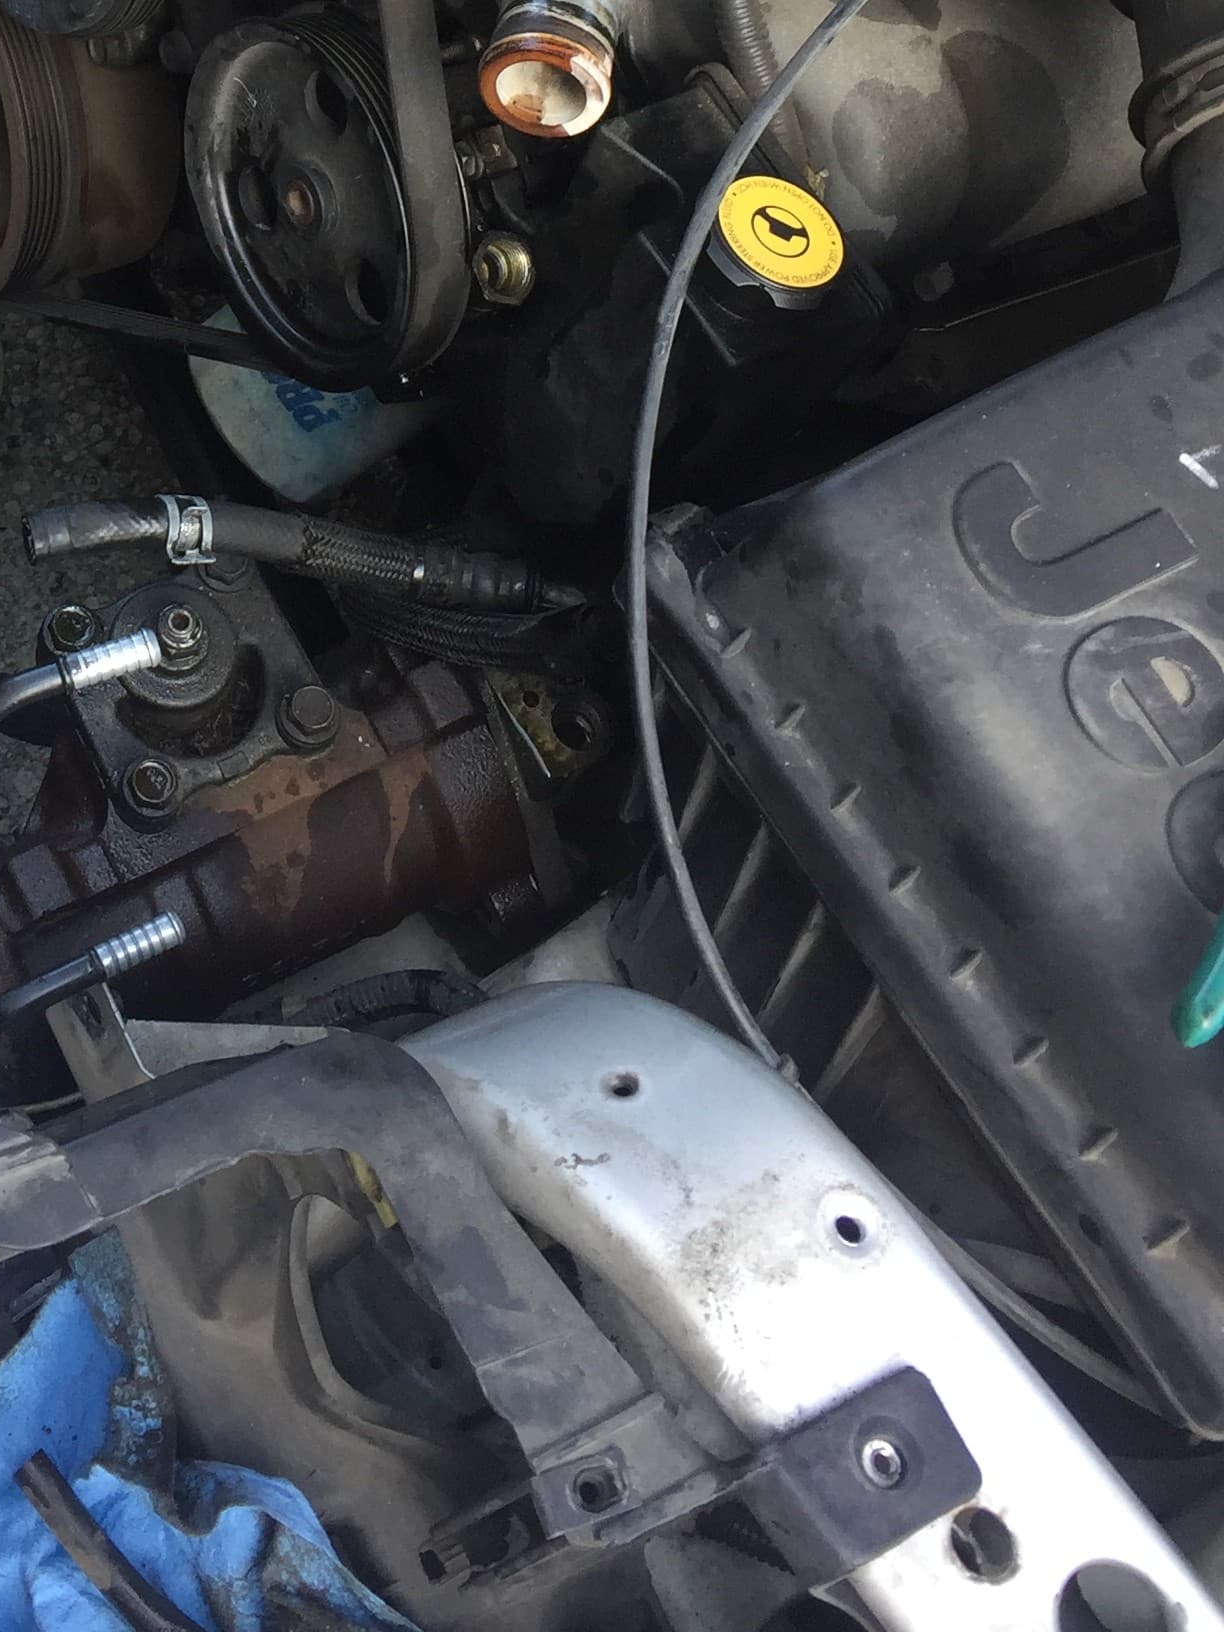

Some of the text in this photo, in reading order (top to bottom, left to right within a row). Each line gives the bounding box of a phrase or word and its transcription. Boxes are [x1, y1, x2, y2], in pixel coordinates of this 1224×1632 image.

[725, 221, 755, 261] STEERING
[753, 258, 790, 281] POWER
[790, 262, 834, 283] APPROVED
